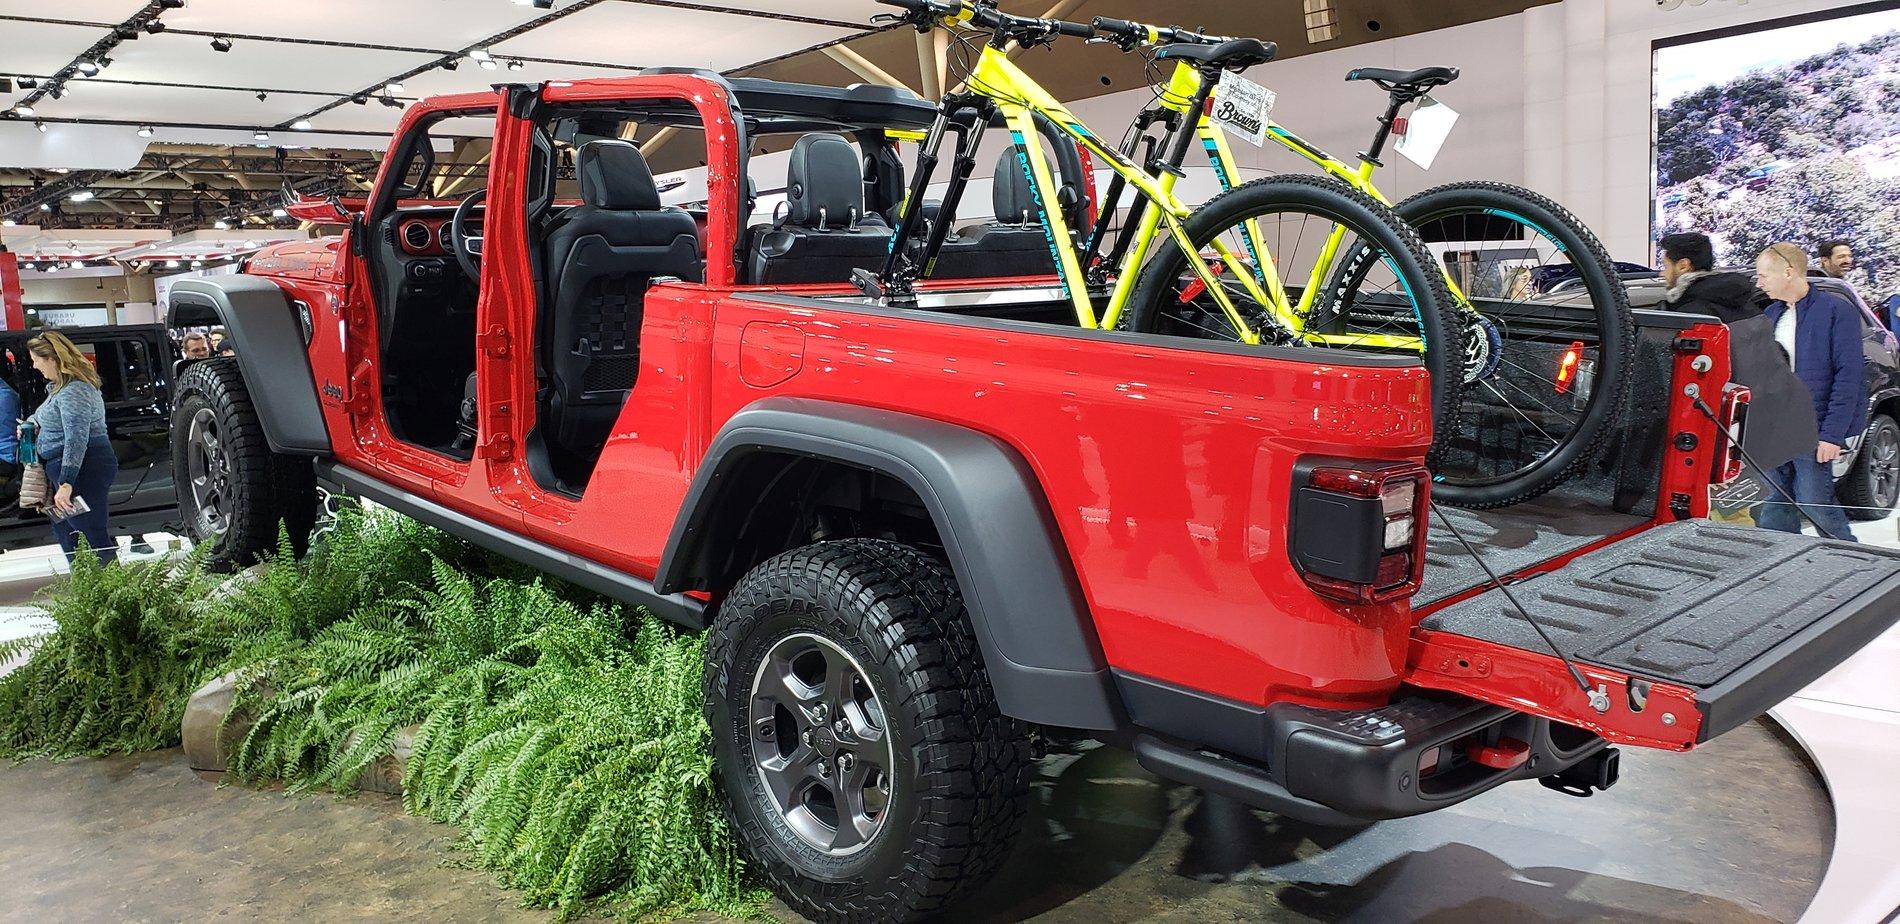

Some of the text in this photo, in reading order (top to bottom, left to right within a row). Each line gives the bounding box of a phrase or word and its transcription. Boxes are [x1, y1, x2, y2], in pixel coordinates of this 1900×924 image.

[1217, 101, 1262, 132] Brown's
[656, 177, 682, 185] YSLER
[1210, 156, 1264, 286] ROCK OUNTAIN
[1017, 152, 1042, 206] ROCKY
[1038, 210, 1071, 300] MOUNTAIN
[1332, 246, 1371, 314] MAXXIS
[717, 598, 828, 700] WILDPEAK
